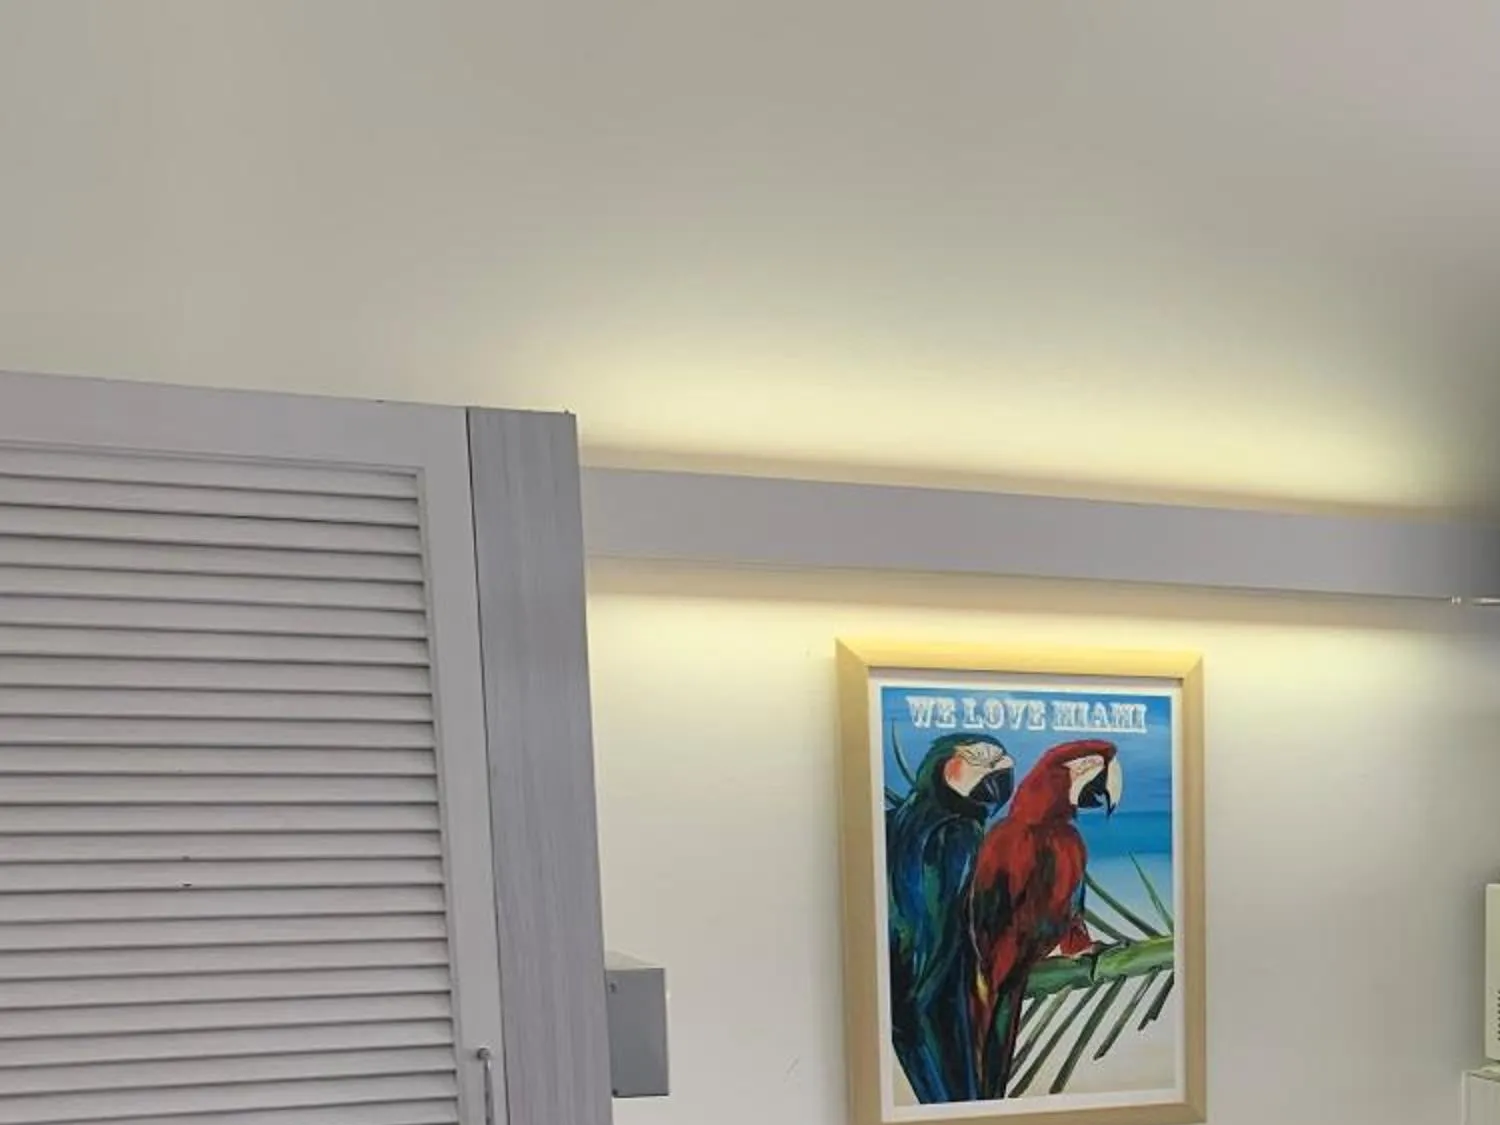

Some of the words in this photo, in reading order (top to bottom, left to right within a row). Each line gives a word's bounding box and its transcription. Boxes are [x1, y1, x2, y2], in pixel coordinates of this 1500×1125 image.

[906, 696, 956, 728] WE
[962, 697, 1046, 731] LOVE
[1052, 700, 1148, 733] MIAMI
